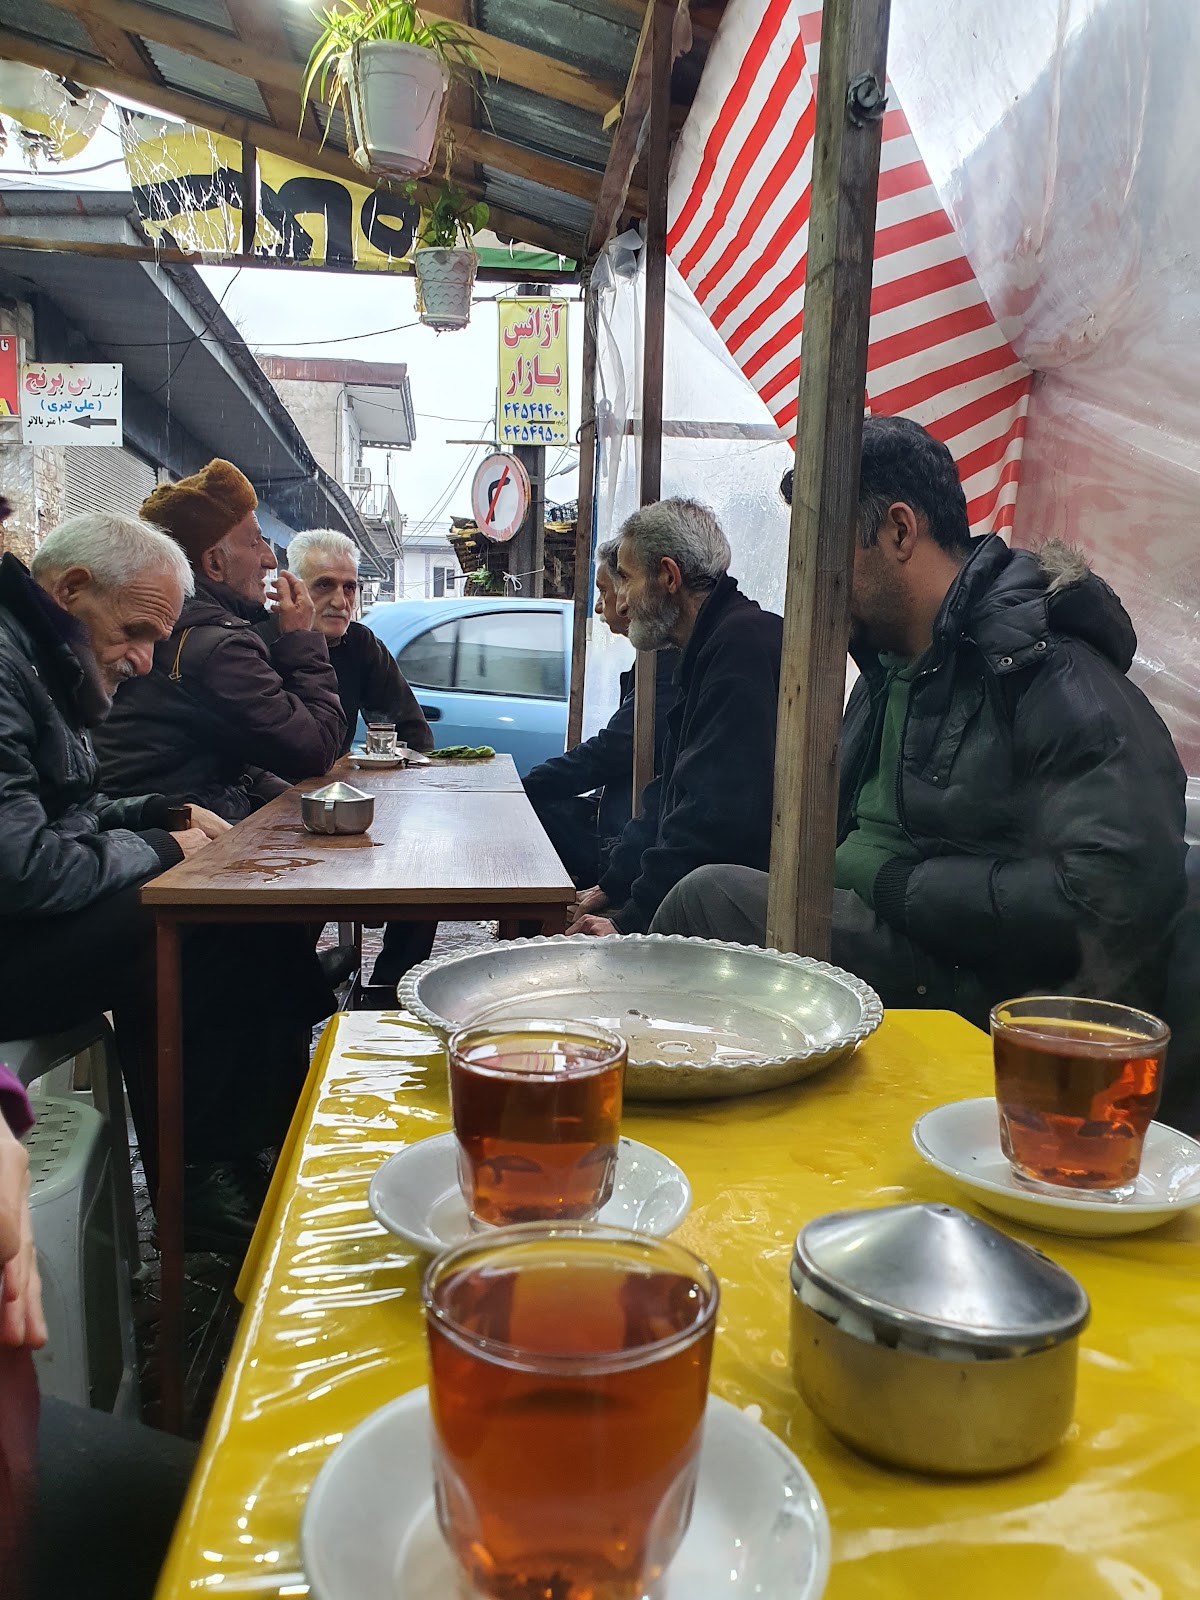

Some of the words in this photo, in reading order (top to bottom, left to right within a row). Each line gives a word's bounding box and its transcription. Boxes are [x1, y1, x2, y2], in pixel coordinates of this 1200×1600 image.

[503, 303, 563, 347] آژانس
[25, 366, 64, 396] برنج
[505, 354, 562, 396] بازار
[503, 402, 565, 419] ۴۴۵۴۹۴۰۰
[46, 417, 56, 428] متر
[503, 425, 565, 442] ۴۴۵۴۹۵۰۰
